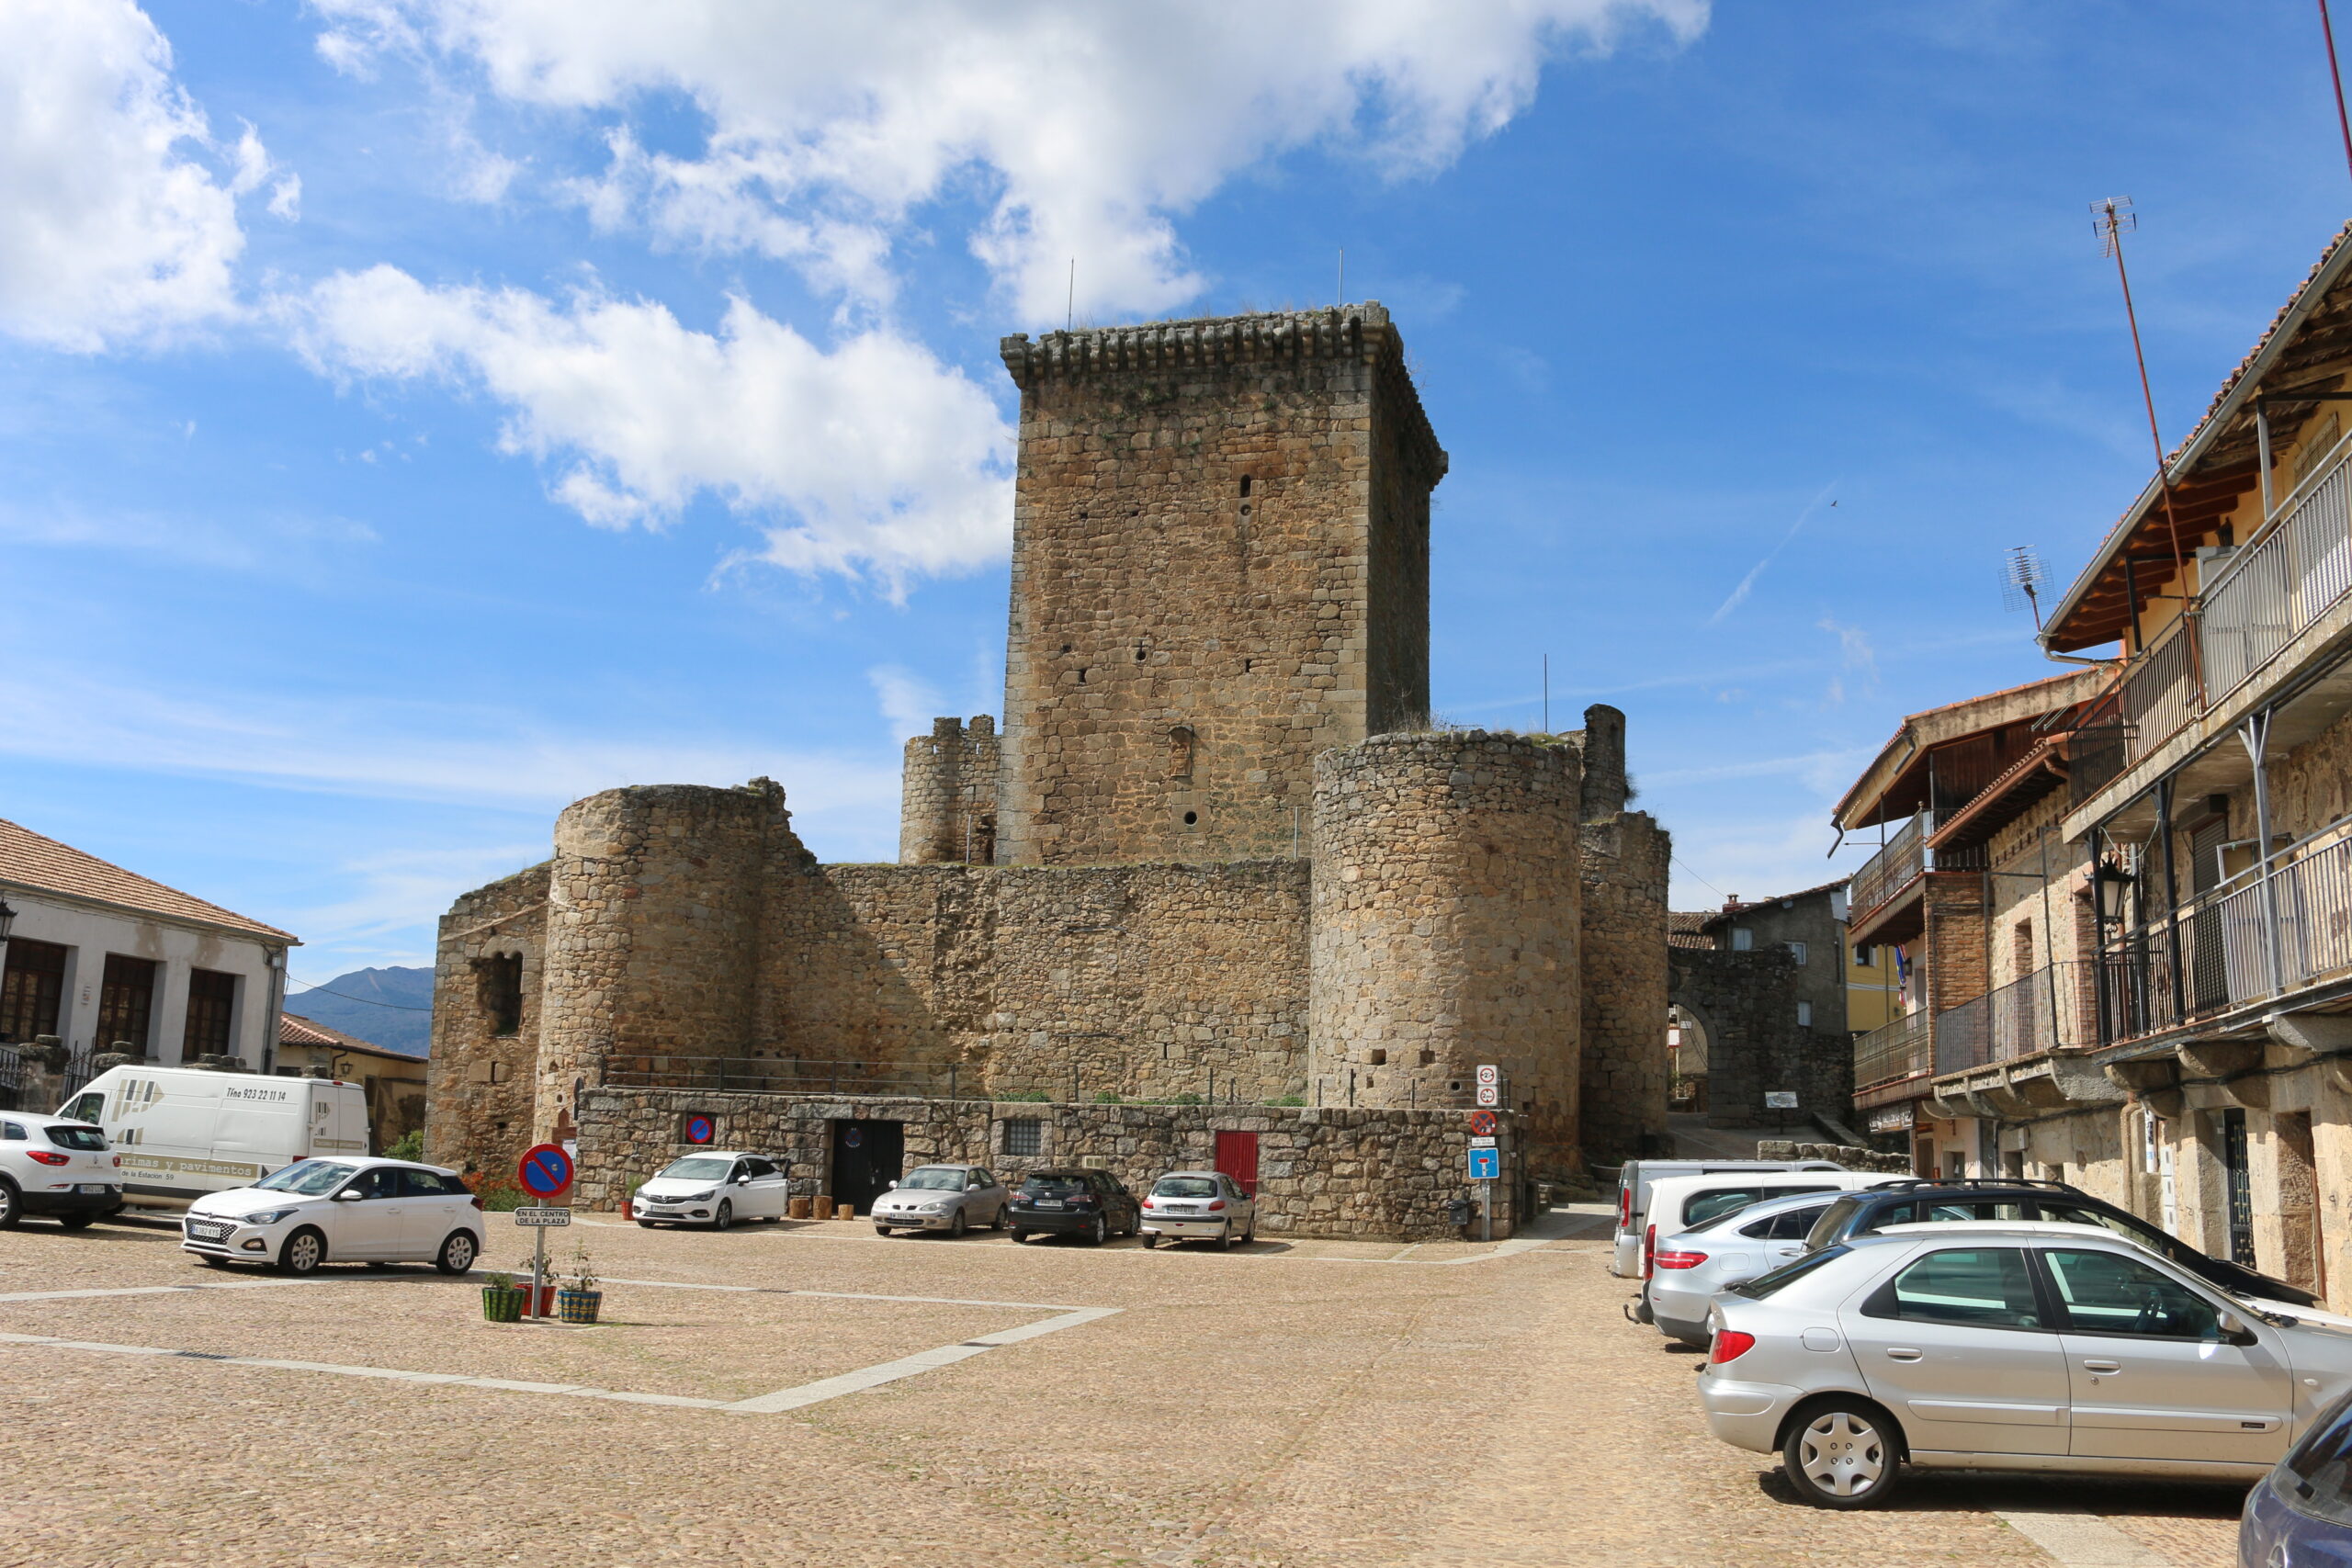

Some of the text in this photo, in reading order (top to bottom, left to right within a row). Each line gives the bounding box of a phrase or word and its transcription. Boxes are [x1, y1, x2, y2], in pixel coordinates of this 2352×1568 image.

[243, 1089, 257, 1099] 923
[258, 1089, 268, 1100] 22
[269, 1090, 277, 1100] 11
[278, 1091, 287, 1101] 14
[119, 1156, 252, 1176] arimas y pavimentos
